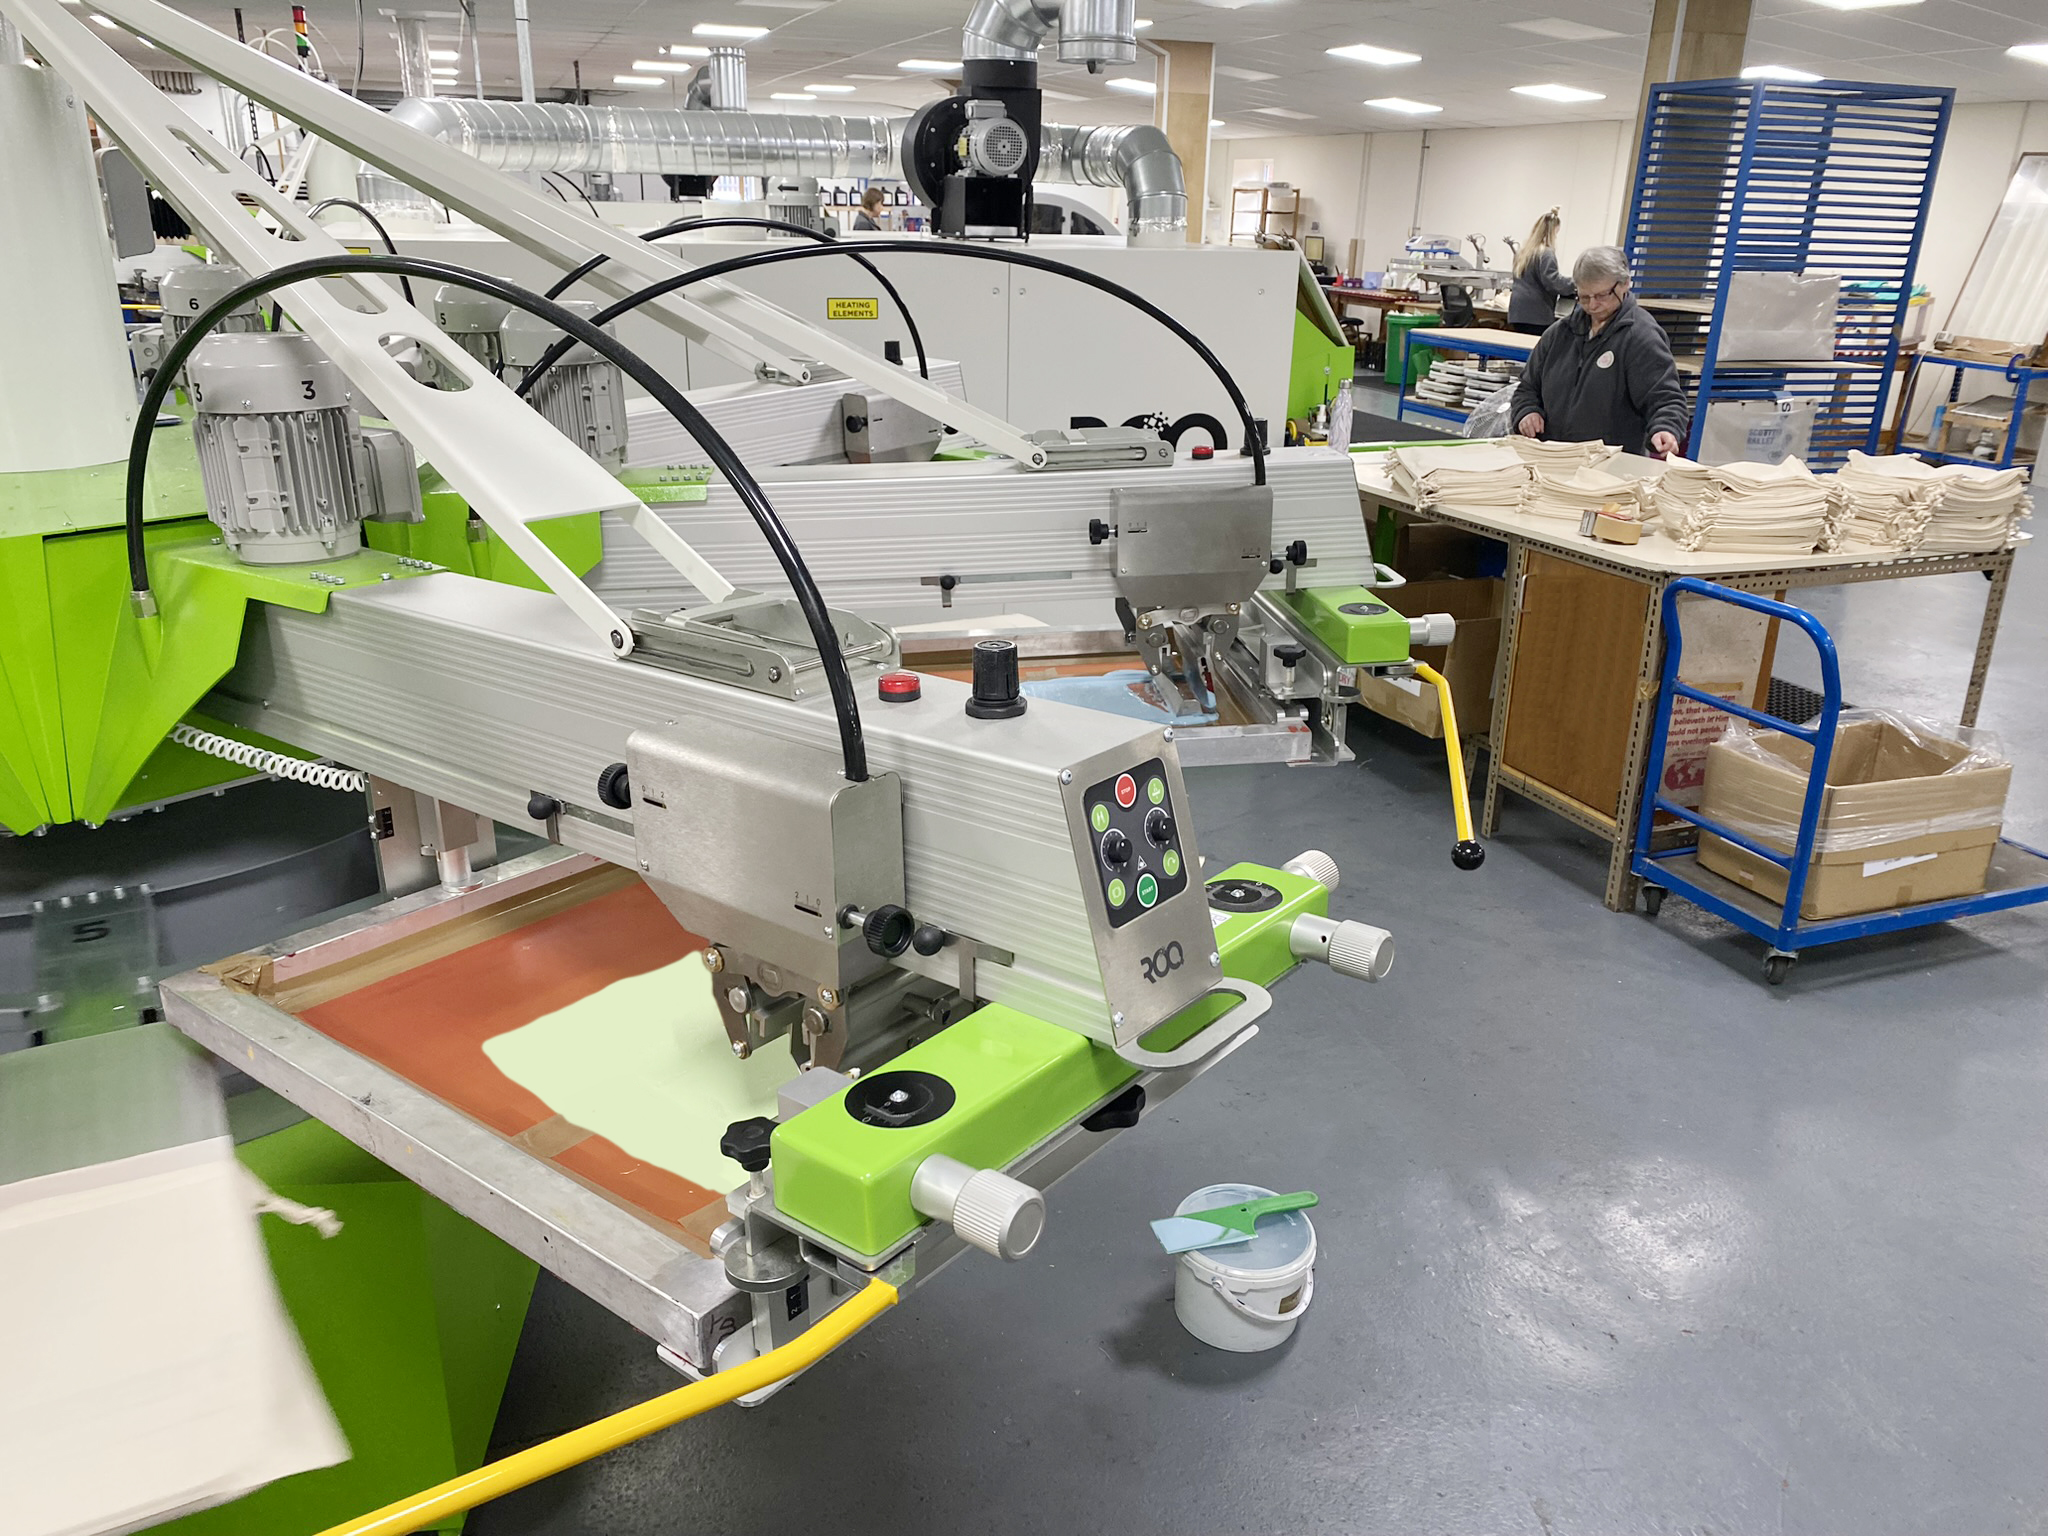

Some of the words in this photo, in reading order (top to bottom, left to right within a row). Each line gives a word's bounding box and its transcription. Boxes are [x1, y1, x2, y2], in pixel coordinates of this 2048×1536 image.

[189, 298, 199, 310] 6
[301, 380, 316, 400] 3
[1674, 716, 1706, 726] believeth
[1120, 786, 1131, 795] STOP
[1142, 885, 1154, 896] START
